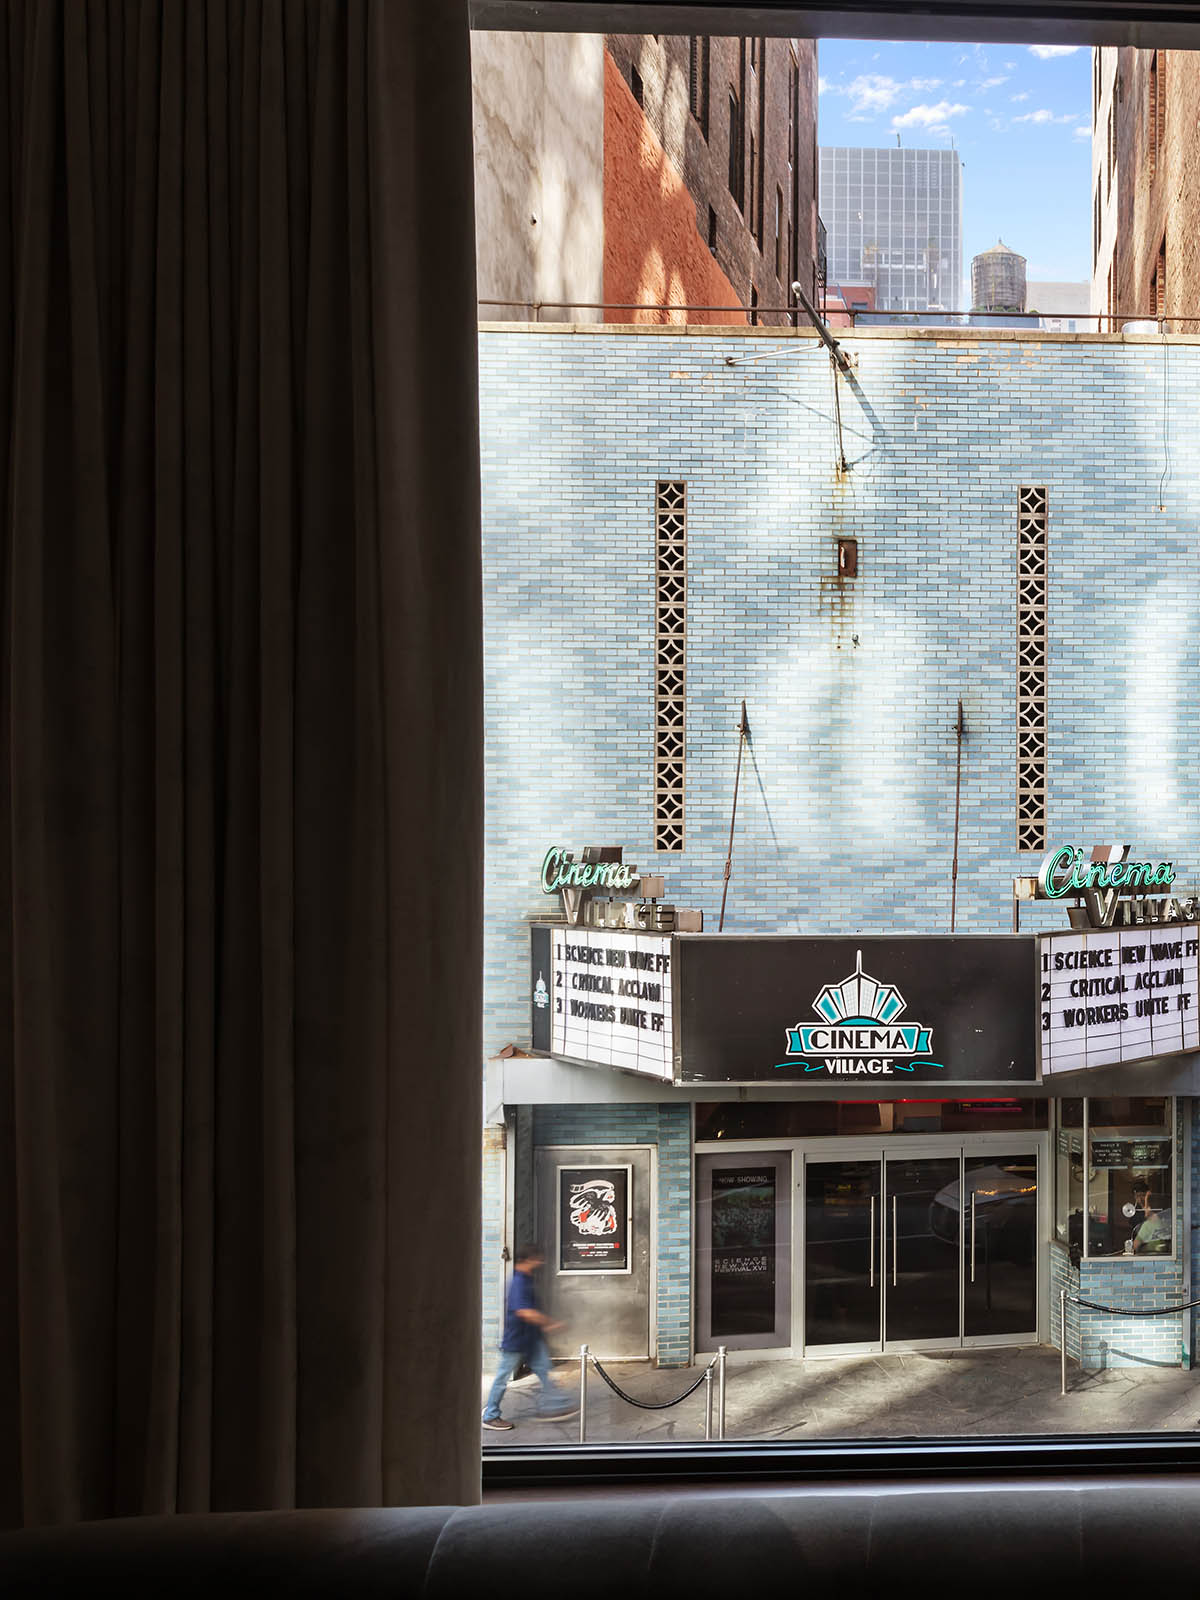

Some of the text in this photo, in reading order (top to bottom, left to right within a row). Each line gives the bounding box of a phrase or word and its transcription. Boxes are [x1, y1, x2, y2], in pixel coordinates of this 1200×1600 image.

[541, 846, 634, 893] Cinema
[1045, 845, 1176, 898] Cinema
[557, 944, 670, 973] 1 SCIENCE NEW WAVE FF
[1043, 939, 1199, 971] 1 SCIENCE NEW WAVE FF
[556, 971, 562, 987] 2
[572, 972, 614, 994] CRITICAL
[1042, 983, 1050, 1001] 2
[1070, 975, 1128, 997] CRITICAL
[557, 997, 562, 1013] 3
[570, 999, 616, 1022] WORKERS
[620, 1007, 647, 1029] UNITE
[651, 1012, 664, 1032] FF
[1042, 993, 1191, 1030] 3 WORKERS UNITE FF
[810, 1030, 908, 1049] CINEMA
[825, 1058, 894, 1074] VILLAGE
[737, 1175, 767, 1183] SHOWING
